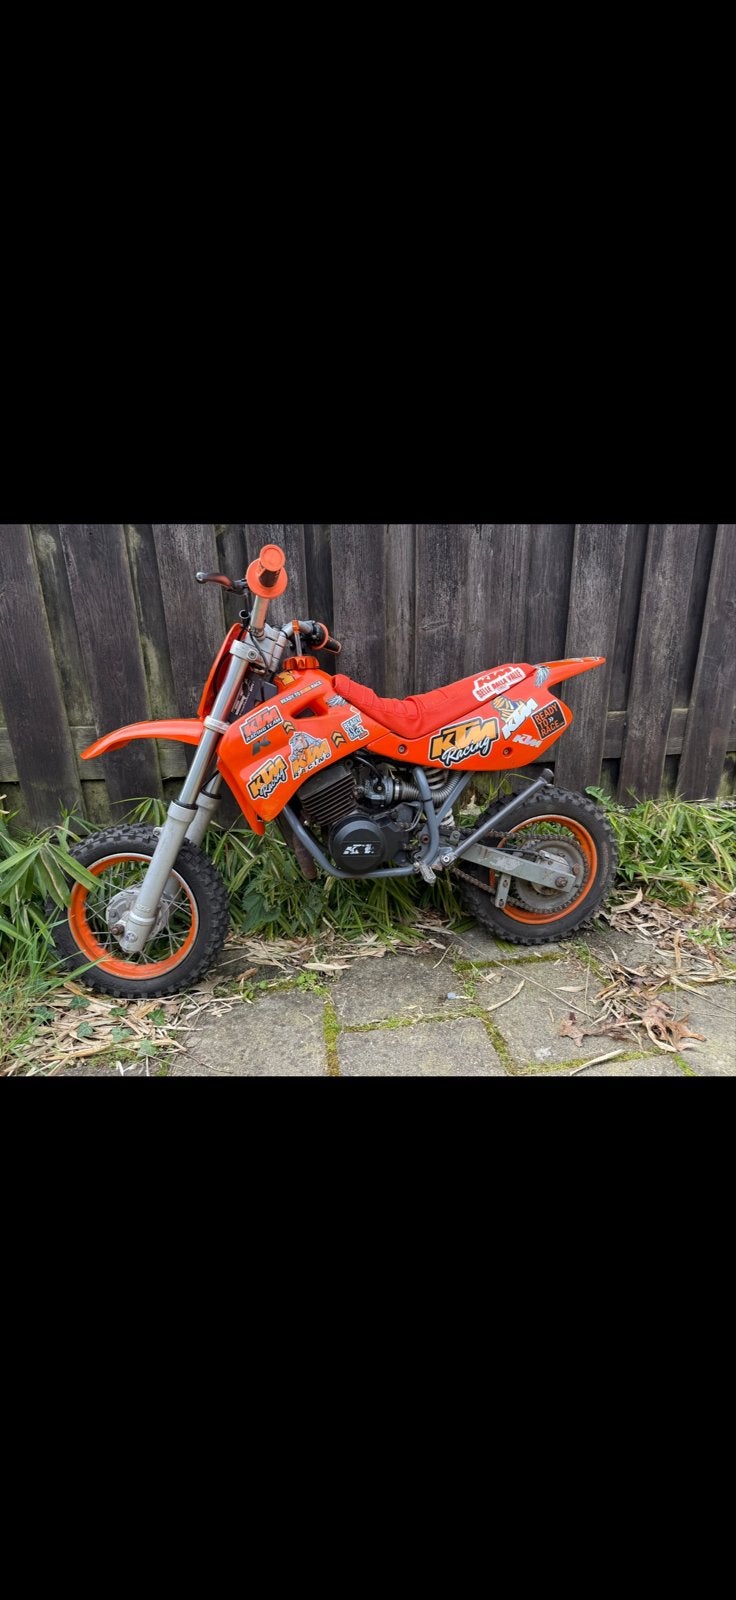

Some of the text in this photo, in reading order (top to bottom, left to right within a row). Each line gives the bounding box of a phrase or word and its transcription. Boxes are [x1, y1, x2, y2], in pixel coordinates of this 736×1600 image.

[243, 707, 280, 738] KTM
[534, 703, 558, 724] READY
[539, 718, 549, 729] TO
[246, 717, 281, 742] RACING TEAM
[431, 718, 499, 759] KTM
[541, 720, 560, 737] RACE
[292, 740, 331, 775] KTM
[442, 738, 490, 764] Racing
[248, 755, 287, 799] KTM
[294, 752, 331, 778] RACING
